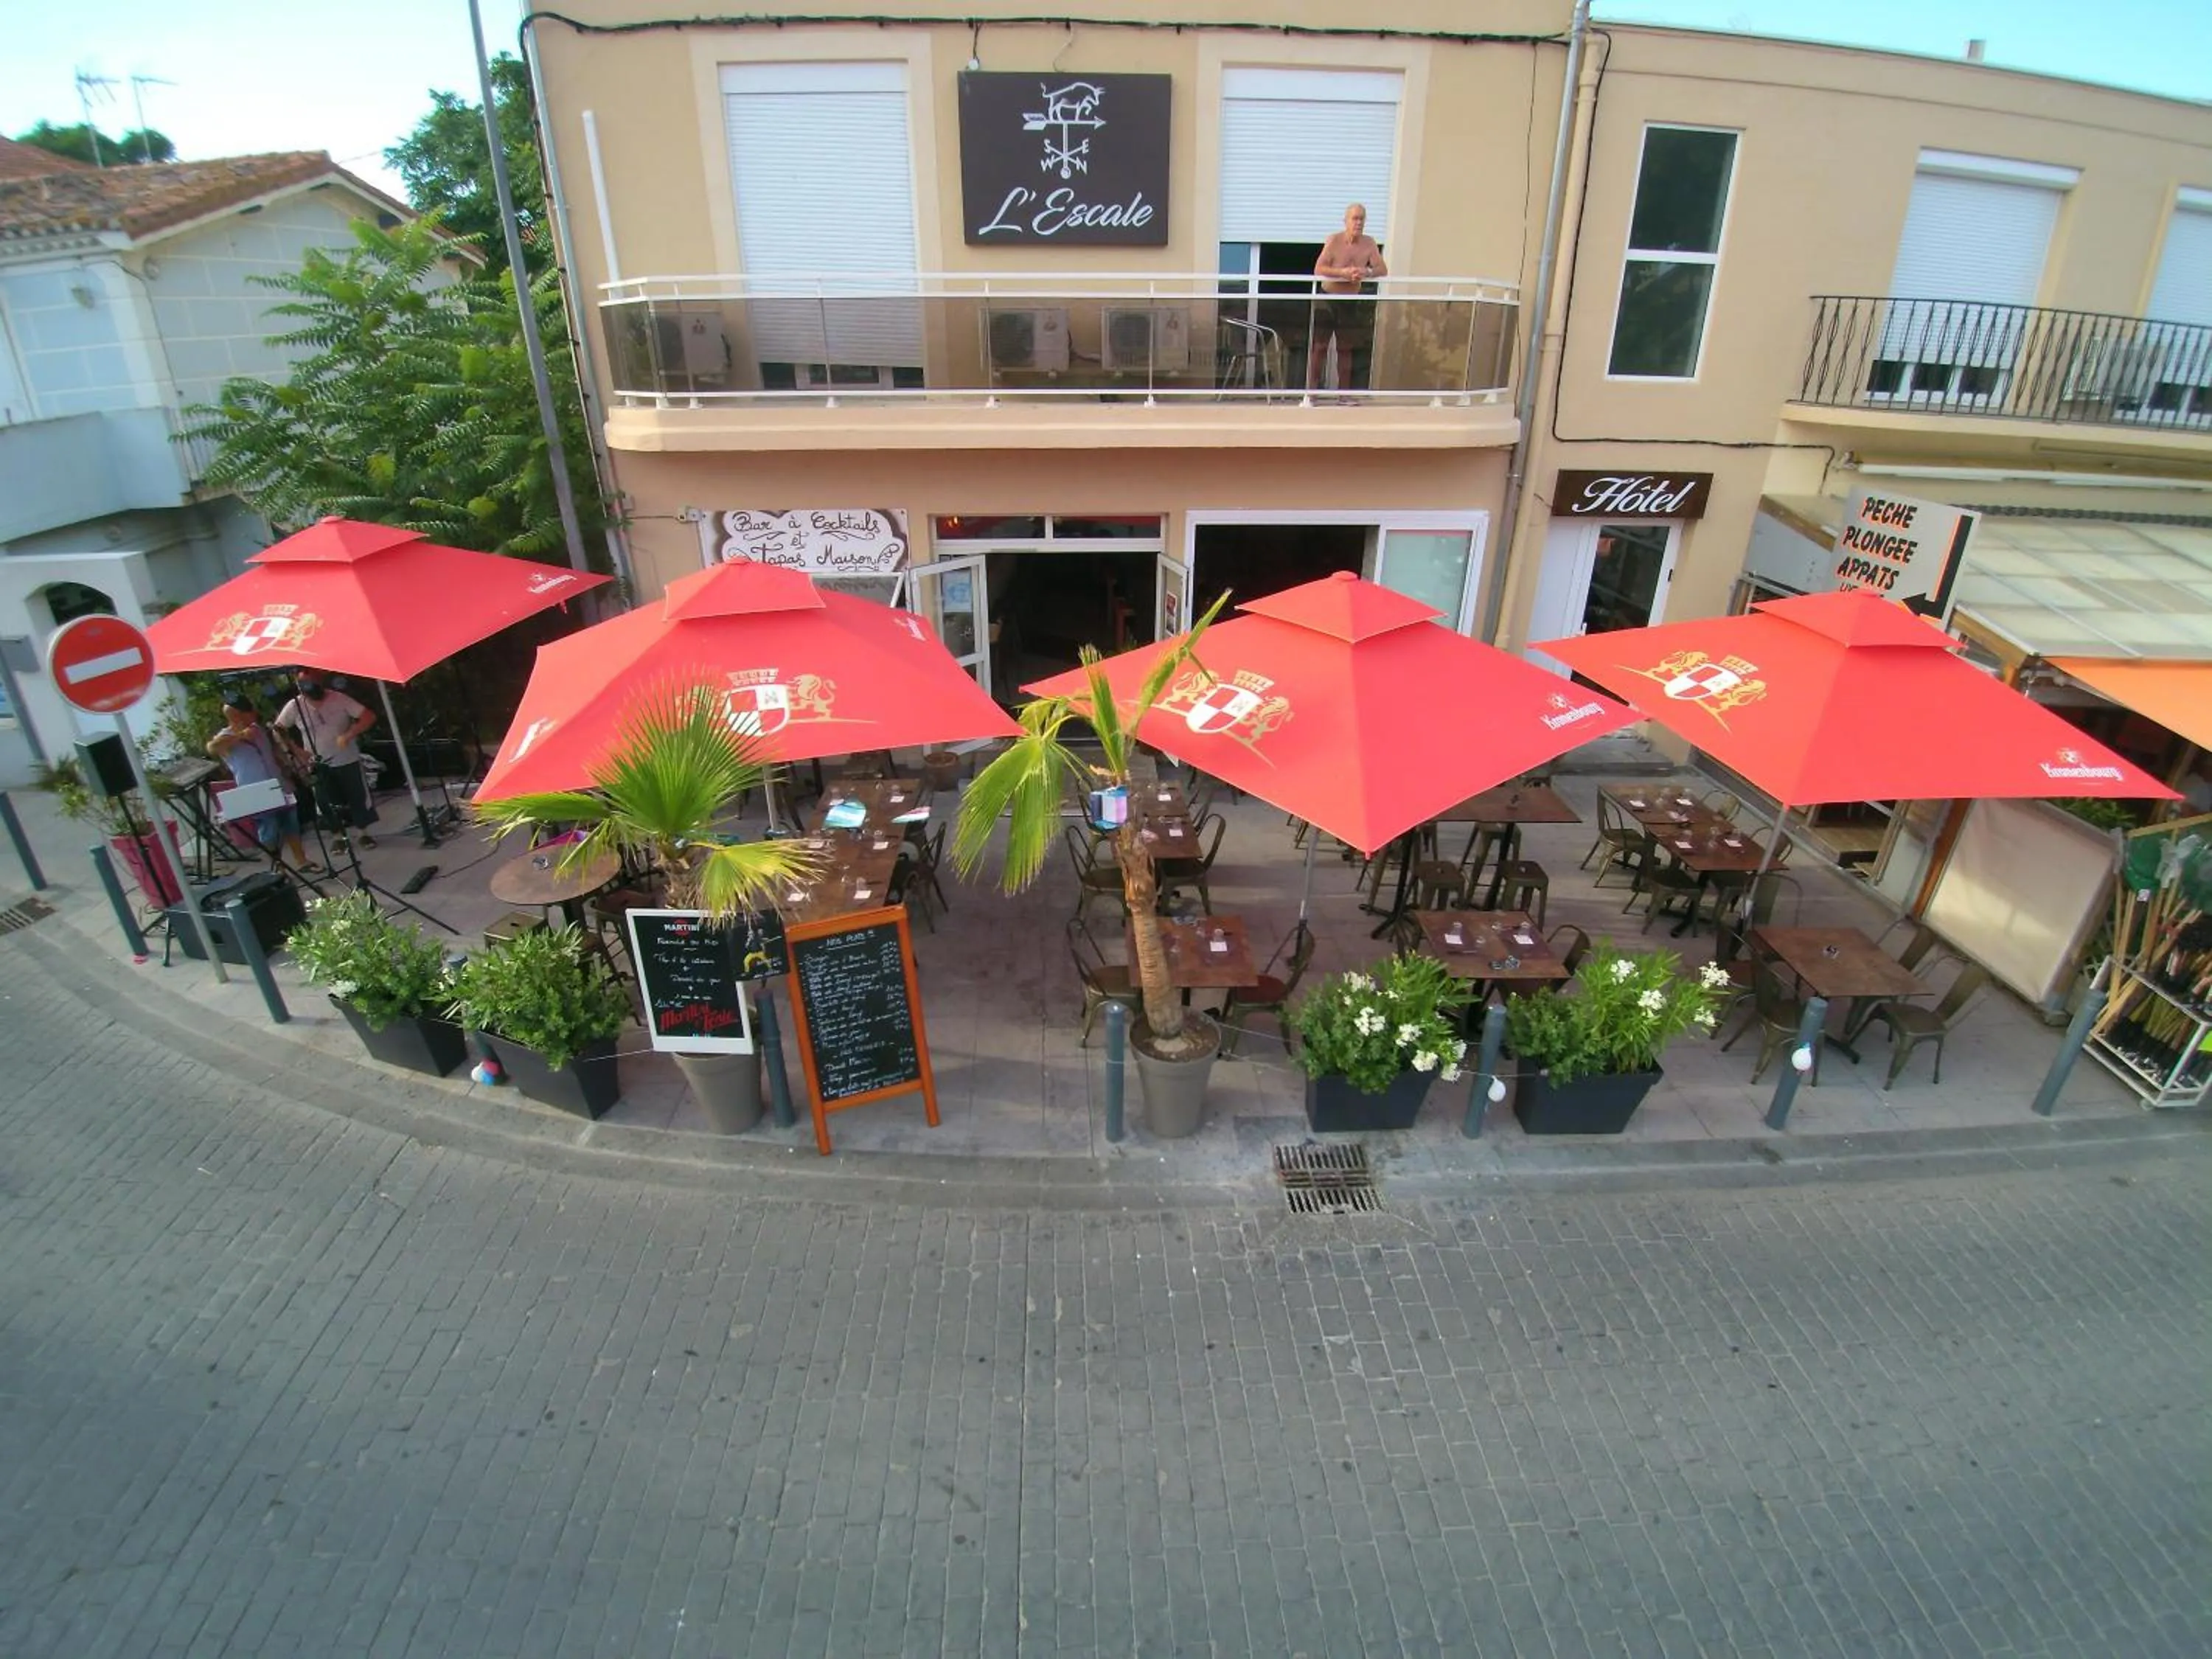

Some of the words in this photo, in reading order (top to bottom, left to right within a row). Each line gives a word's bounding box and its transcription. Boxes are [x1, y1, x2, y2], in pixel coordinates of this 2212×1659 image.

[978, 187, 1154, 235] L'Escale
[1571, 476, 1696, 512] Hôtel
[732, 511, 772, 532] Bar
[788, 516, 801, 529] à
[810, 511, 880, 533] Cocktails
[1860, 497, 1917, 529] PECHE
[751, 543, 805, 566] Tapas
[816, 545, 877, 566] Maison
[790, 532, 810, 546] et
[1842, 526, 1918, 564] PLONGEE
[1837, 557, 1900, 591] APPATS
